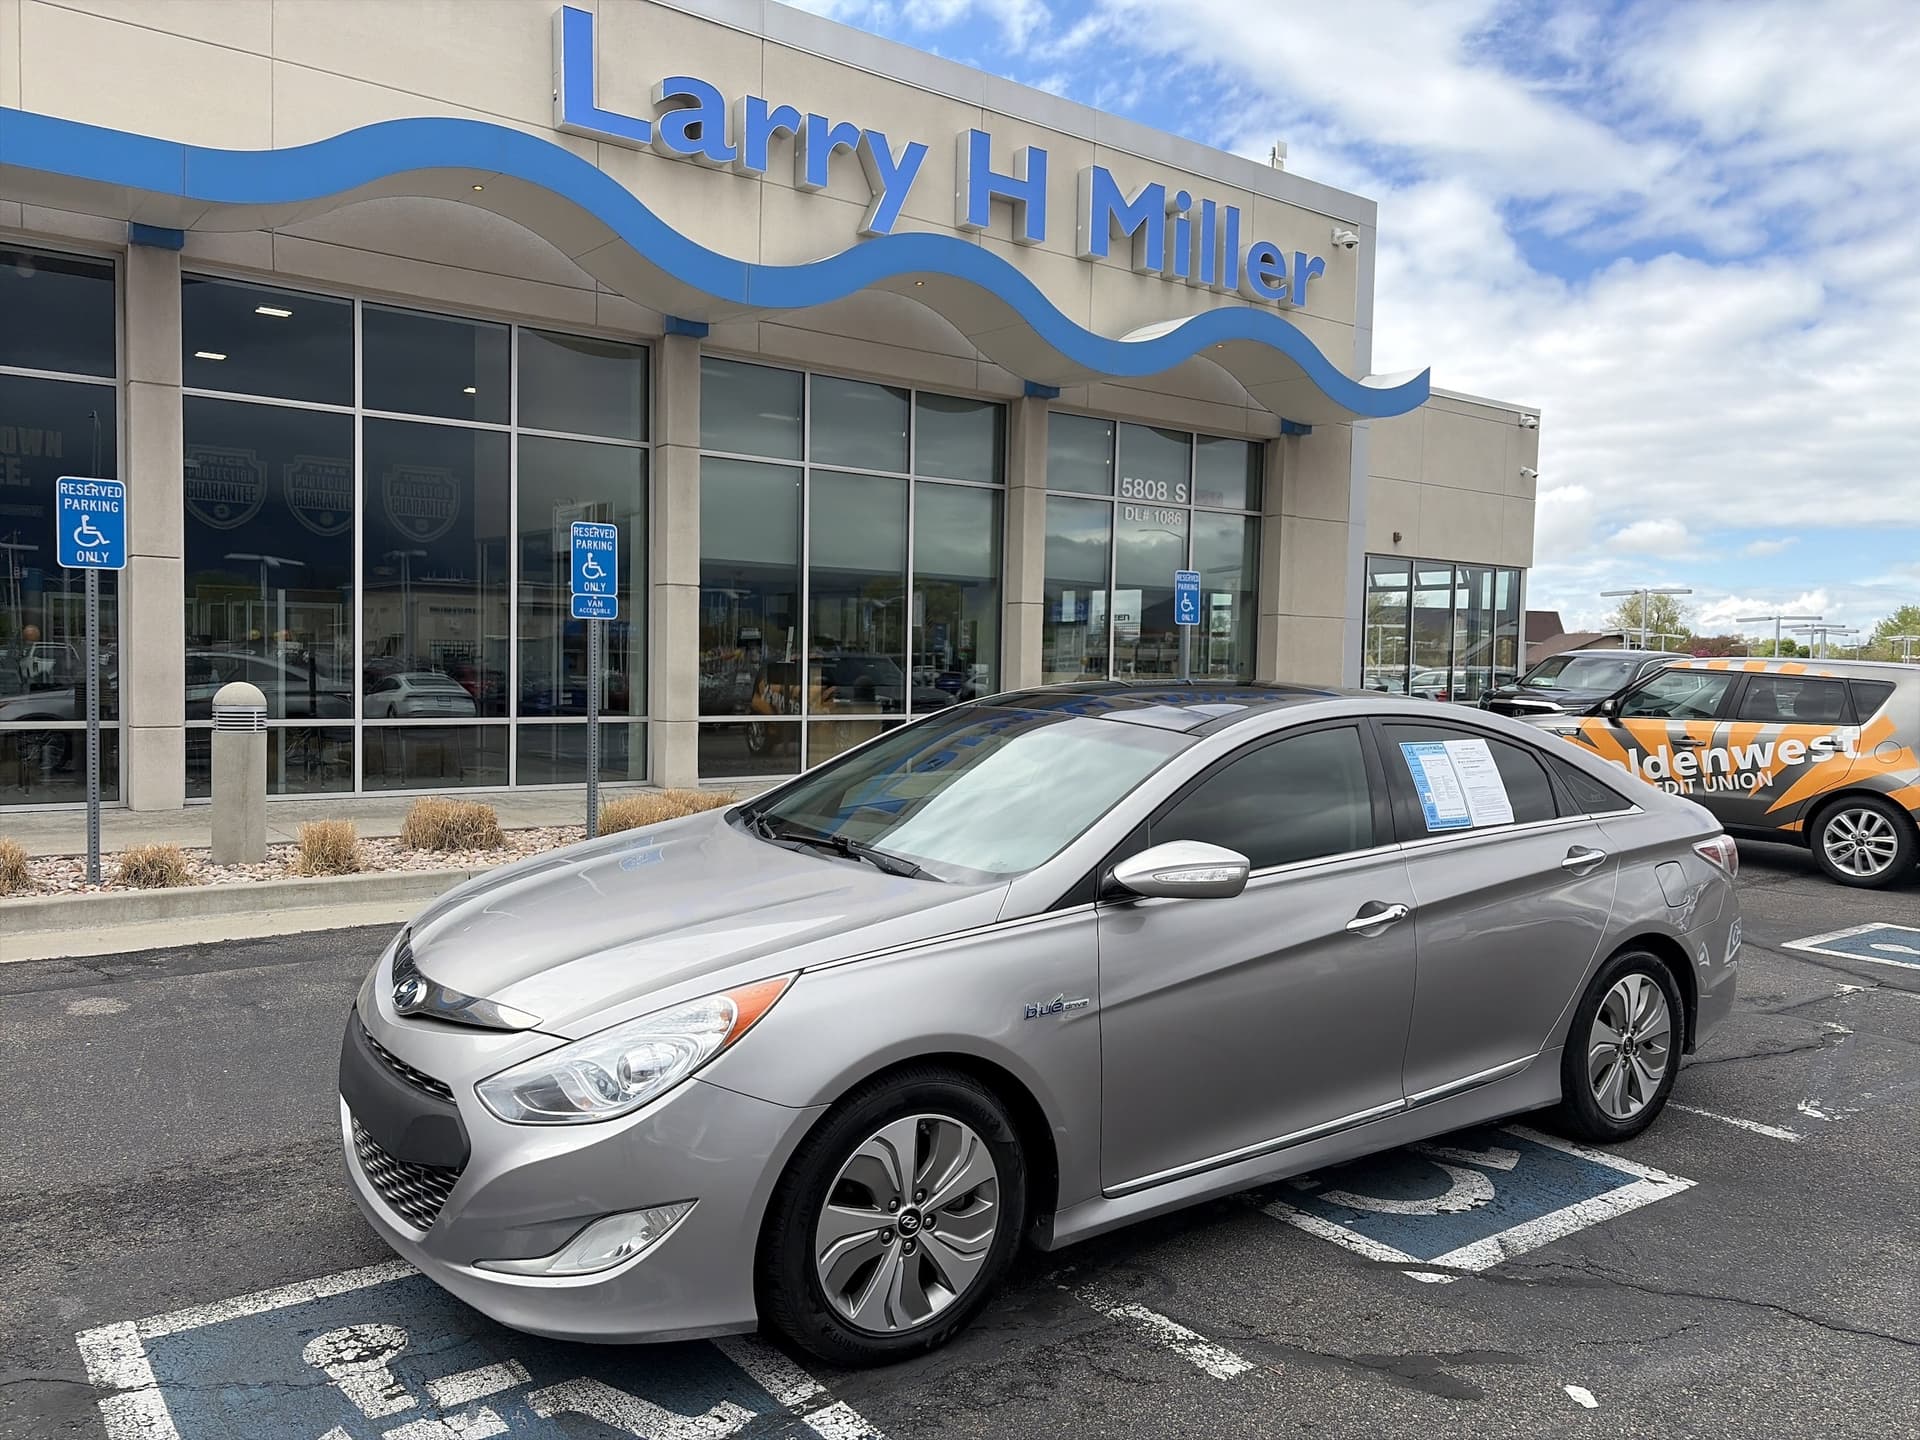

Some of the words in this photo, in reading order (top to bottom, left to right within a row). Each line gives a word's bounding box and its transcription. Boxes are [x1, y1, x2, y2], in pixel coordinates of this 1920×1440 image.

[554, 5, 928, 238] Larry
[957, 128, 1048, 246] H
[1077, 165, 1326, 309] Miller
[60, 483, 122, 498] RESERVED
[1121, 477, 1168, 500] 5808
[1175, 483, 1187, 502] S
[64, 498, 119, 513] PARKING
[1154, 510, 1182, 525] 1086
[573, 526, 615, 539] RESERVED
[576, 539, 613, 551] PARKING
[76, 550, 109, 563] ONLY
[583, 582, 606, 592] ONLY
[579, 607, 611, 615] ACCESSIBLE
[587, 599, 603, 608] VAN
[1609, 728, 1862, 779] ldenwest
[1703, 771, 1775, 793] UNION
